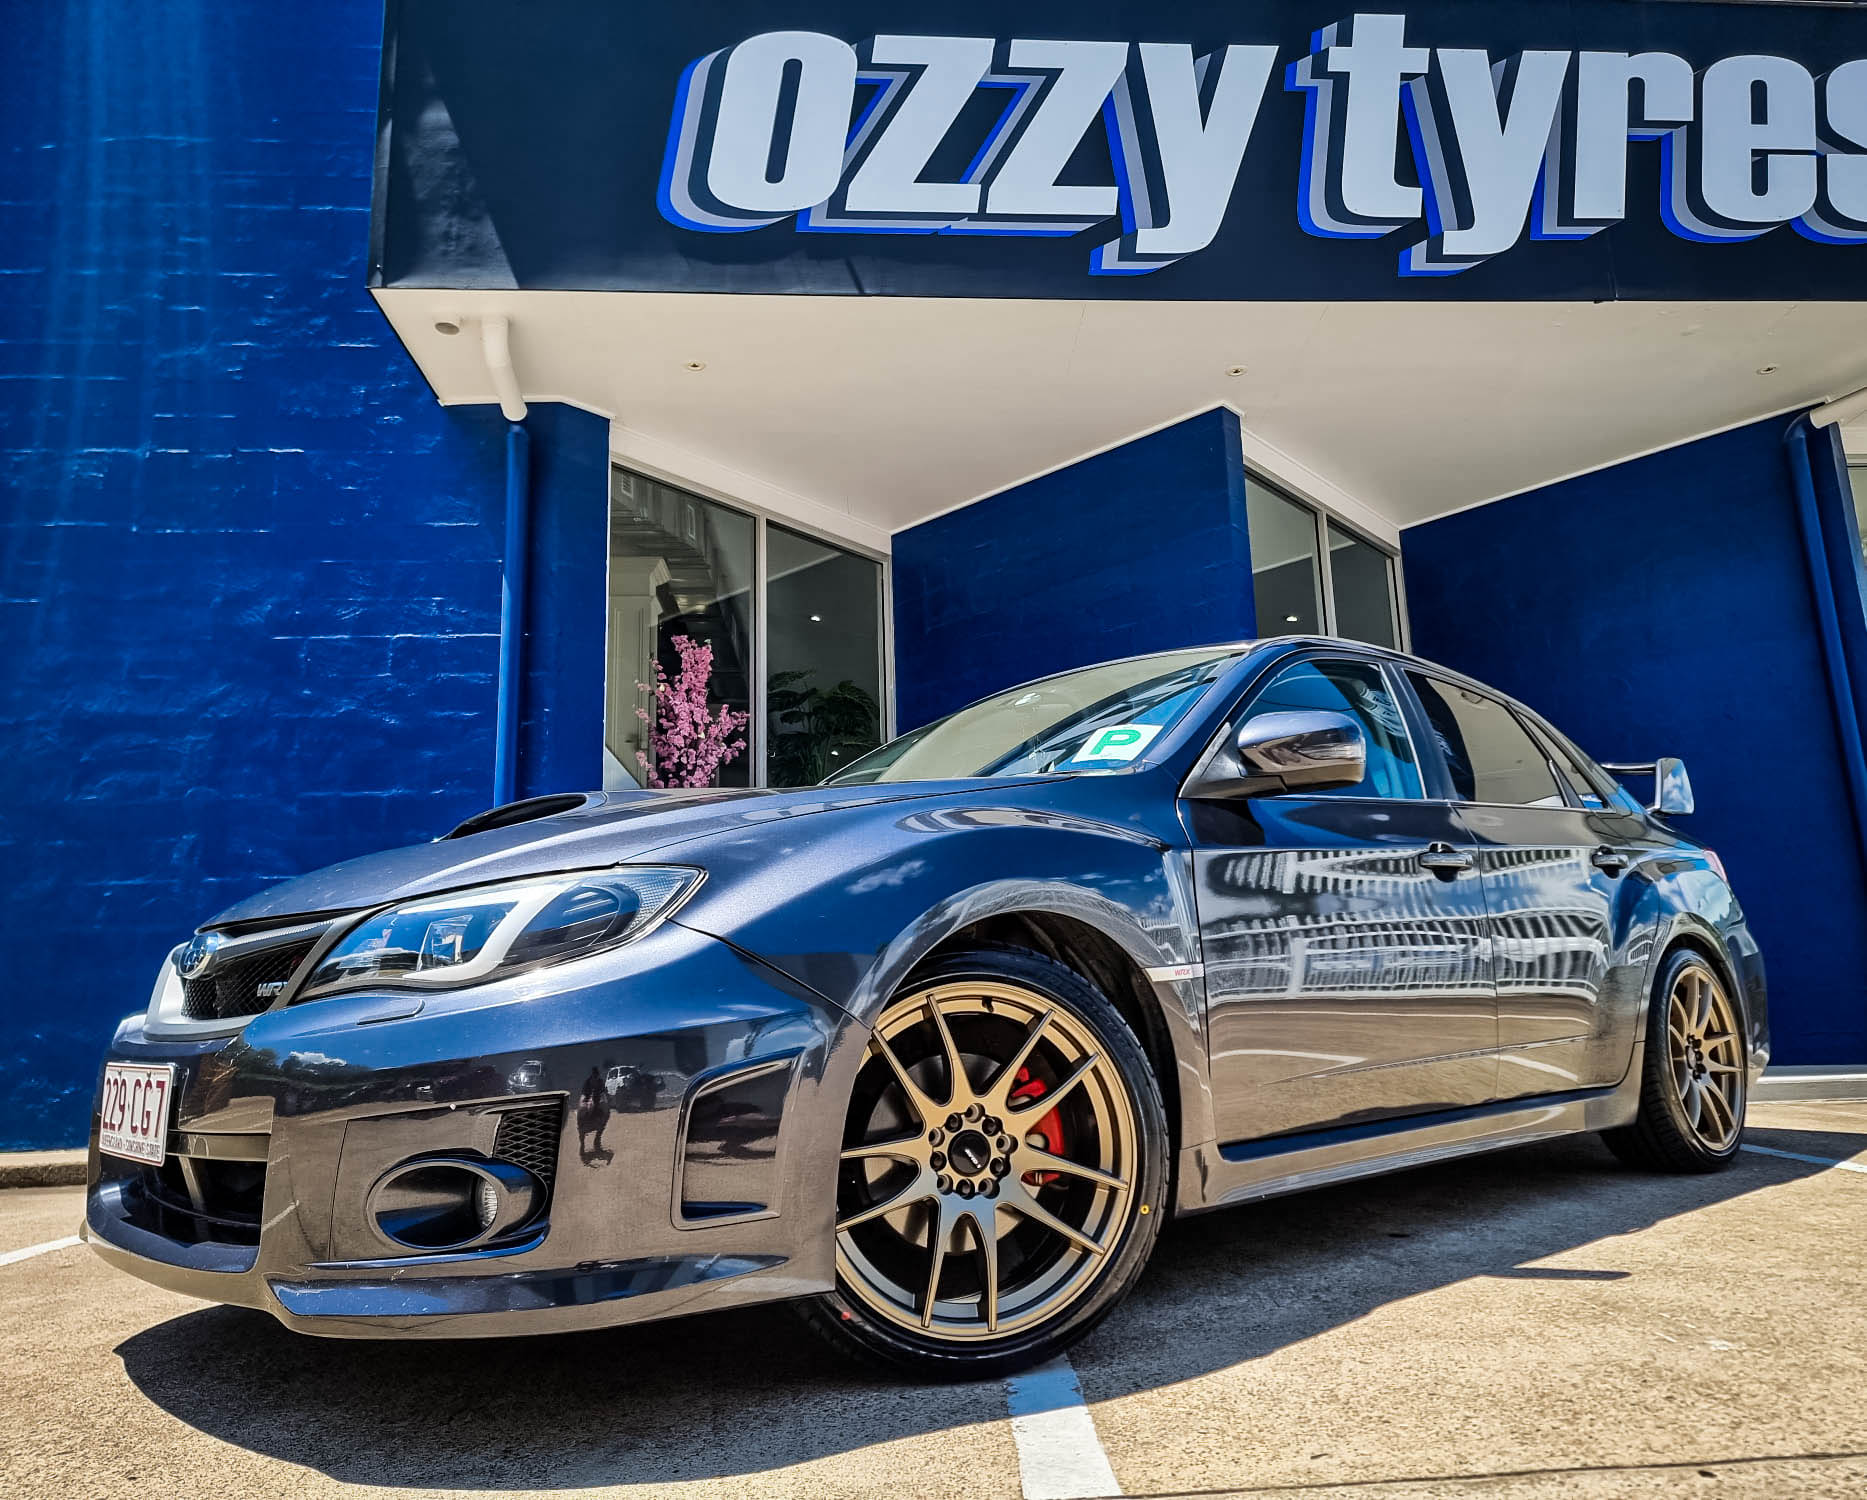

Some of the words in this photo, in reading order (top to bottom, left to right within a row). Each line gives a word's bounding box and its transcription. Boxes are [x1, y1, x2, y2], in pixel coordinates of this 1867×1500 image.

[706, 30, 1280, 254] ozzy
[1088, 729, 1142, 755] P
[256, 981, 289, 997] WR
[102, 1077, 127, 1132] 229
[130, 1078, 166, 1138] CG7
